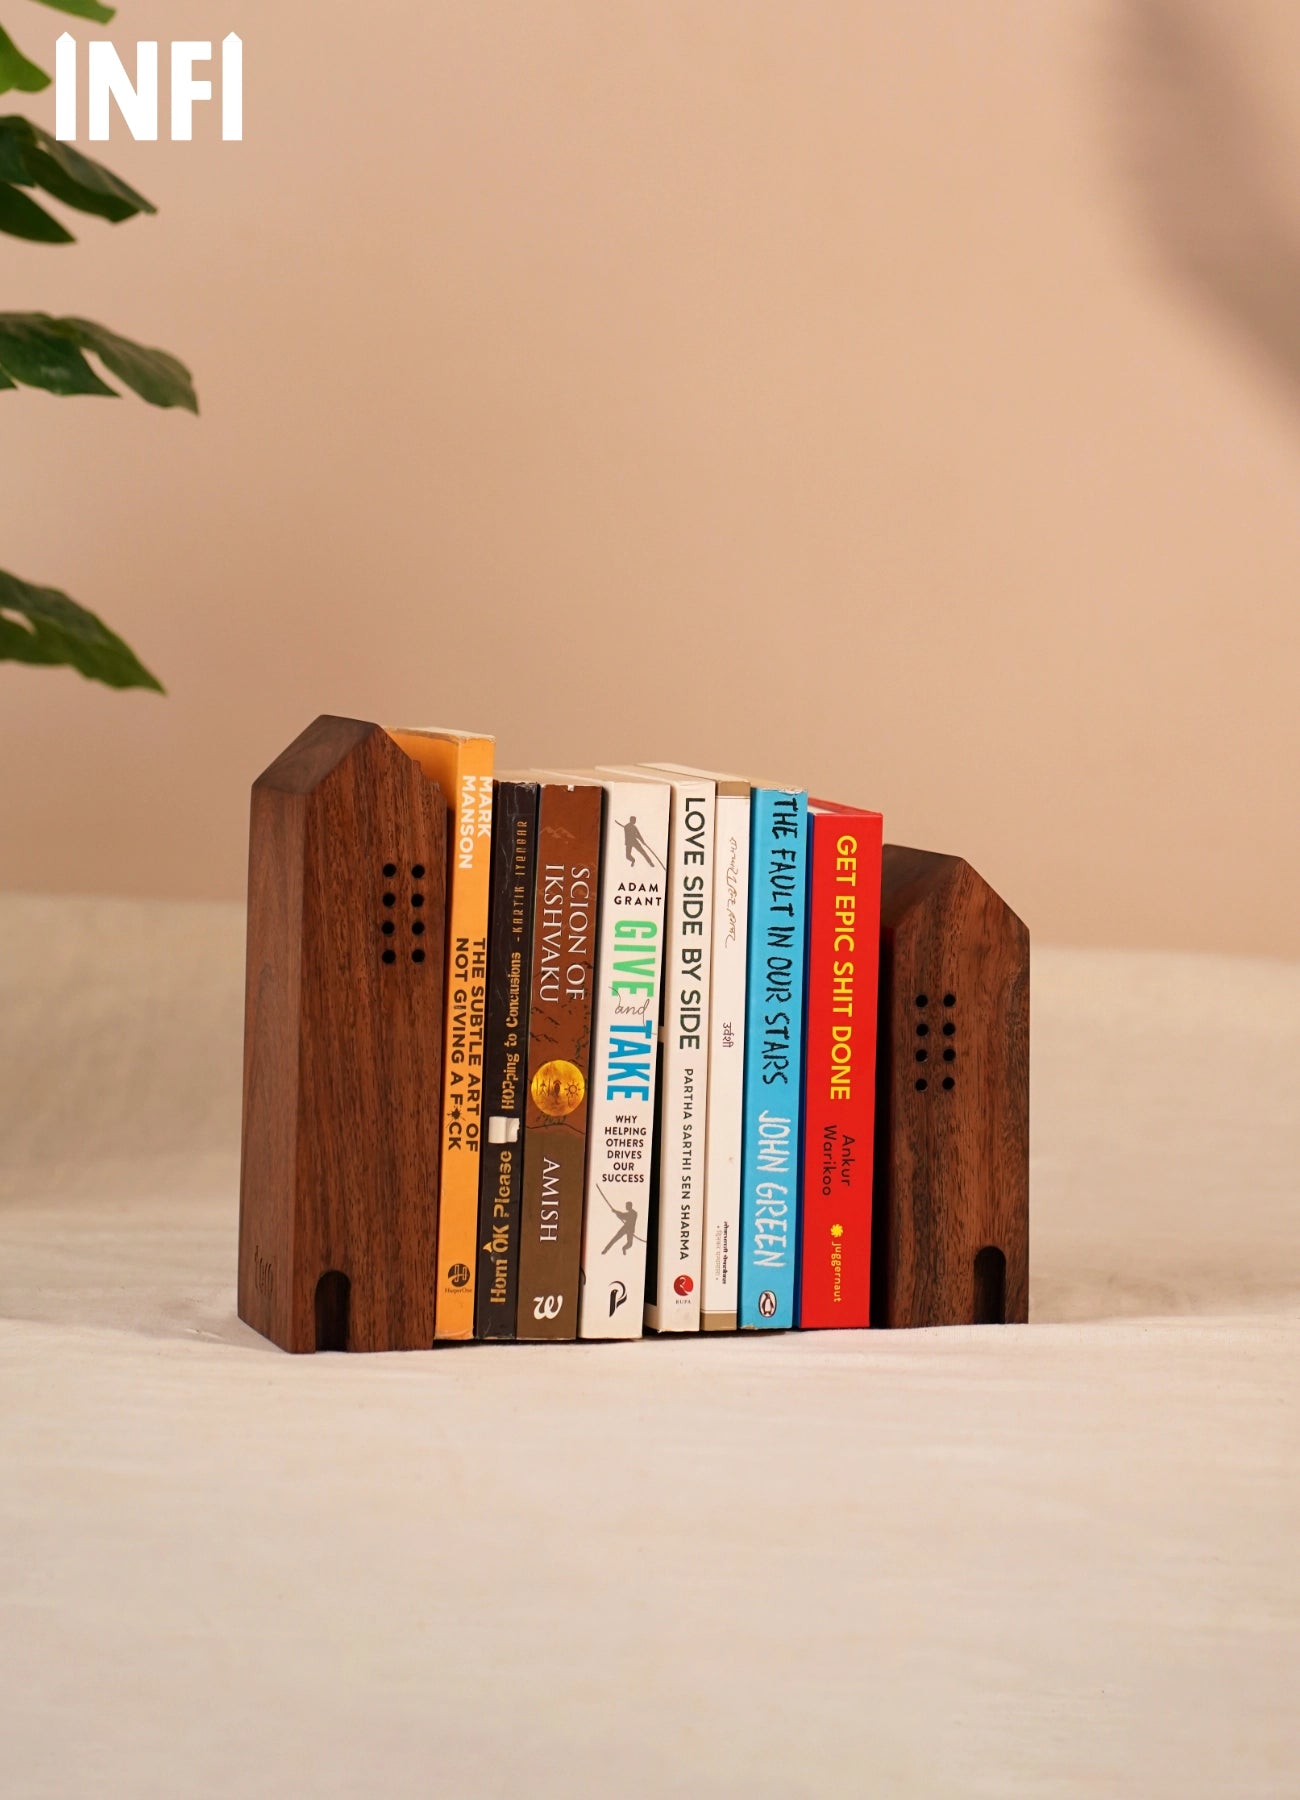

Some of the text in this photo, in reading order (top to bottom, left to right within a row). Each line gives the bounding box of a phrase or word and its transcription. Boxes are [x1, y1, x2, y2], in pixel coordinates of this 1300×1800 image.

[458, 775, 477, 869] MANSON
[477, 775, 493, 838] MARK
[613, 895, 663, 907] GRANT
[617, 882, 660, 893] ADAM
[539, 864, 565, 1003] IKSHVAKU
[566, 866, 591, 1001] SCION OF
[679, 797, 706, 1050] LOVE SIDE BY SIDE
[760, 797, 798, 1085] THE FAULT IN OUR STARS
[454, 937, 470, 982] NOT
[611, 919, 658, 997] GIVE
[830, 835, 858, 1100] GET EPIC SHIT DONE
[450, 989, 468, 1065] GIVING
[465, 937, 486, 1152] THE SUBTLE ART OF
[503, 1033, 519, 1047] to
[606, 1019, 653, 1102] TAKE
[721, 1021, 735, 1048] उर्वशी
[450, 1072, 464, 1086] A
[604, 1126, 648, 1137] HELPING
[605, 1138, 645, 1149] OTHERS
[615, 1115, 638, 1125] WHY
[602, 1173, 645, 1183] SUCCESS
[607, 1149, 643, 1160] DRIVES
[613, 1161, 635, 1172] OUR
[679, 1068, 694, 1261] PARTHA SARTHI SEN SHARMA
[821, 1125, 837, 1197] Warikoo
[841, 1134, 856, 1187] Ankur
[539, 1156, 561, 1242] AMISH
[753, 1109, 791, 1268] JOHN GREEN
[490, 1150, 513, 1304] Horn OK Please
[830, 1241, 843, 1303] juggernaut
